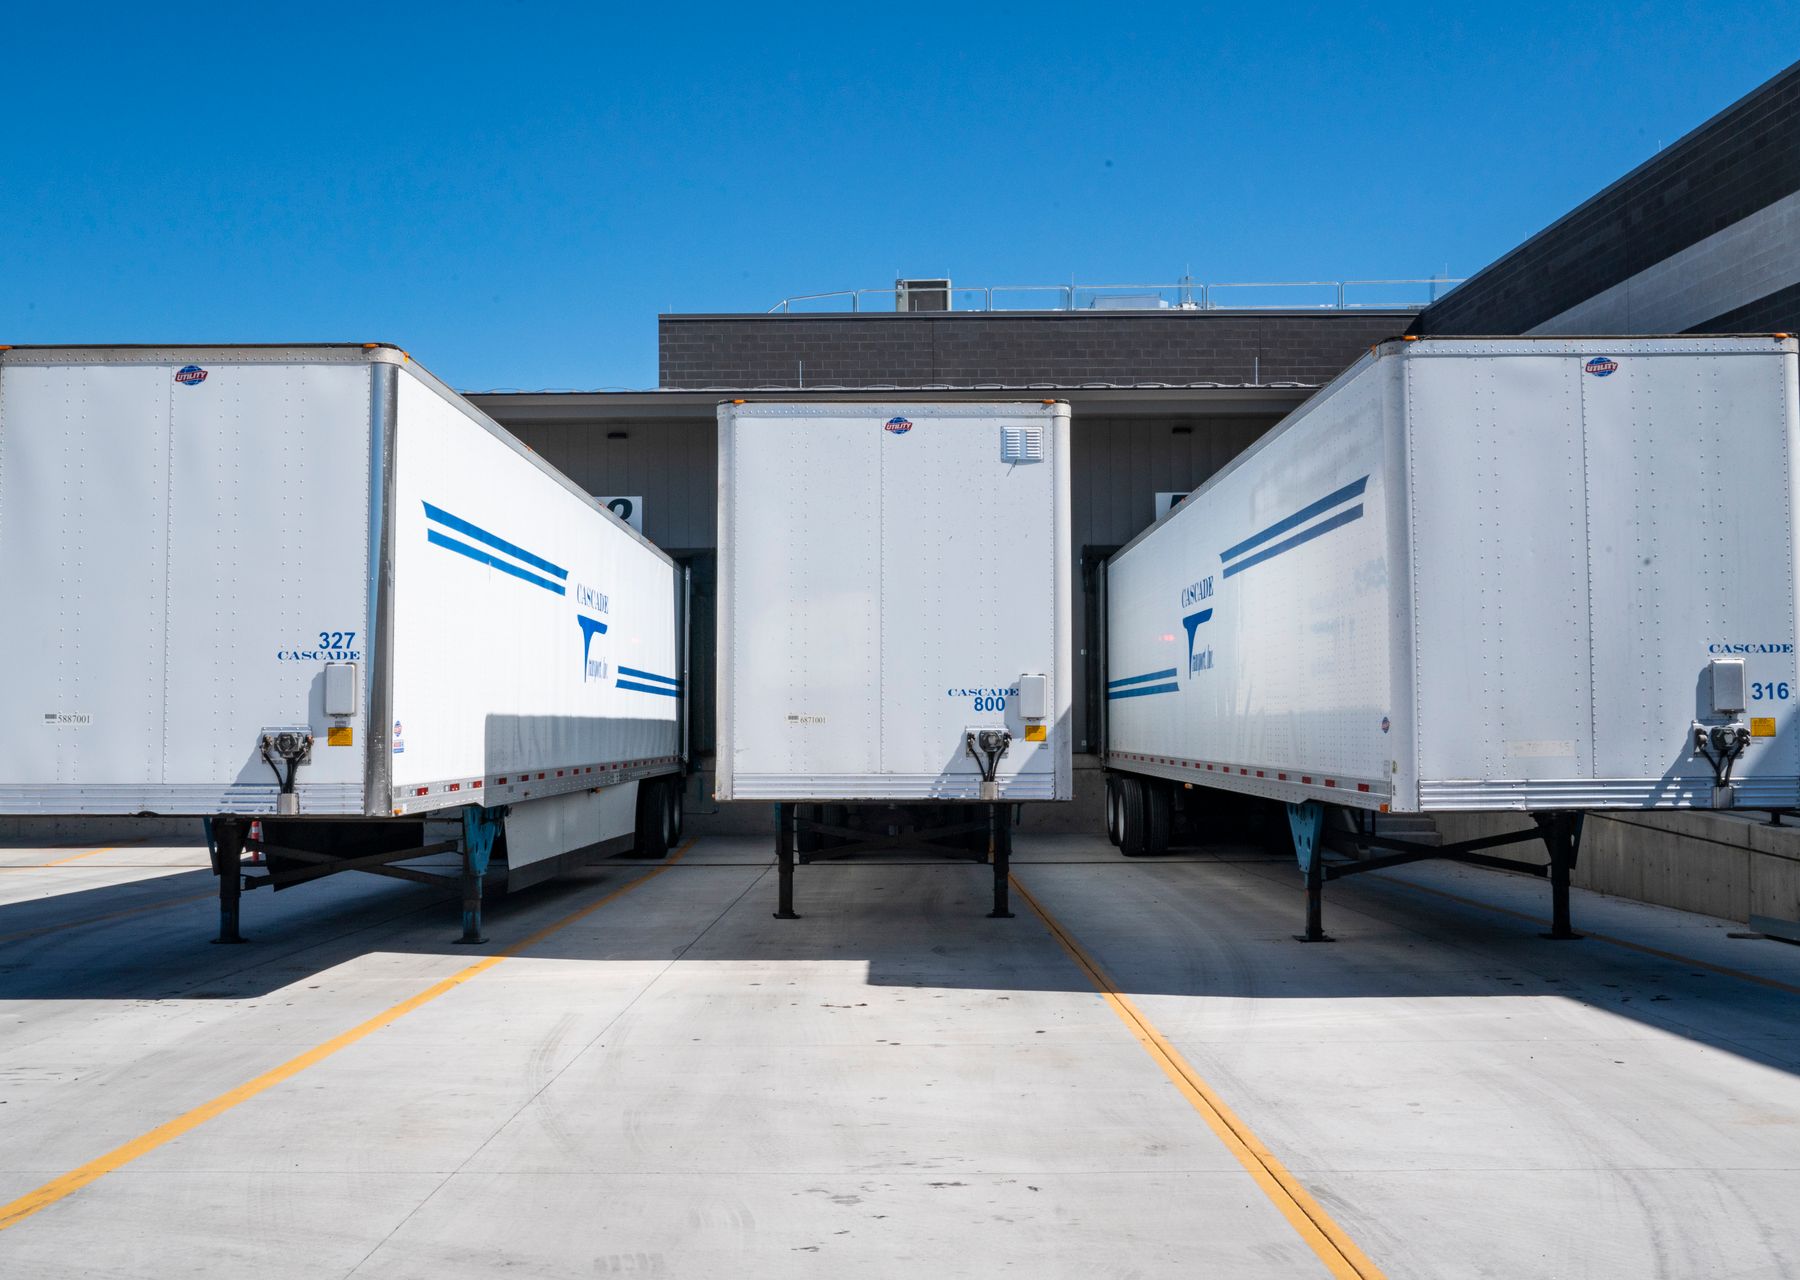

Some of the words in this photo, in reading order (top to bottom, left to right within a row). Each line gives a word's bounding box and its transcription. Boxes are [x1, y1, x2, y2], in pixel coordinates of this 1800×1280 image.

[1586, 363, 1618, 372] UTILITY
[176, 371, 207, 381] UTILITY
[886, 422, 912, 430] UTILITY
[1182, 575, 1214, 608] CASCADE
[577, 583, 609, 614] CASCADE
[319, 632, 356, 649] 327
[1709, 644, 1794, 654] CASCADE
[277, 651, 360, 661] CASCADE
[947, 688, 1019, 697] CASCADE
[1751, 682, 1790, 700] 316
[974, 697, 1006, 711] 800
[58, 714, 90, 723] 5887001
